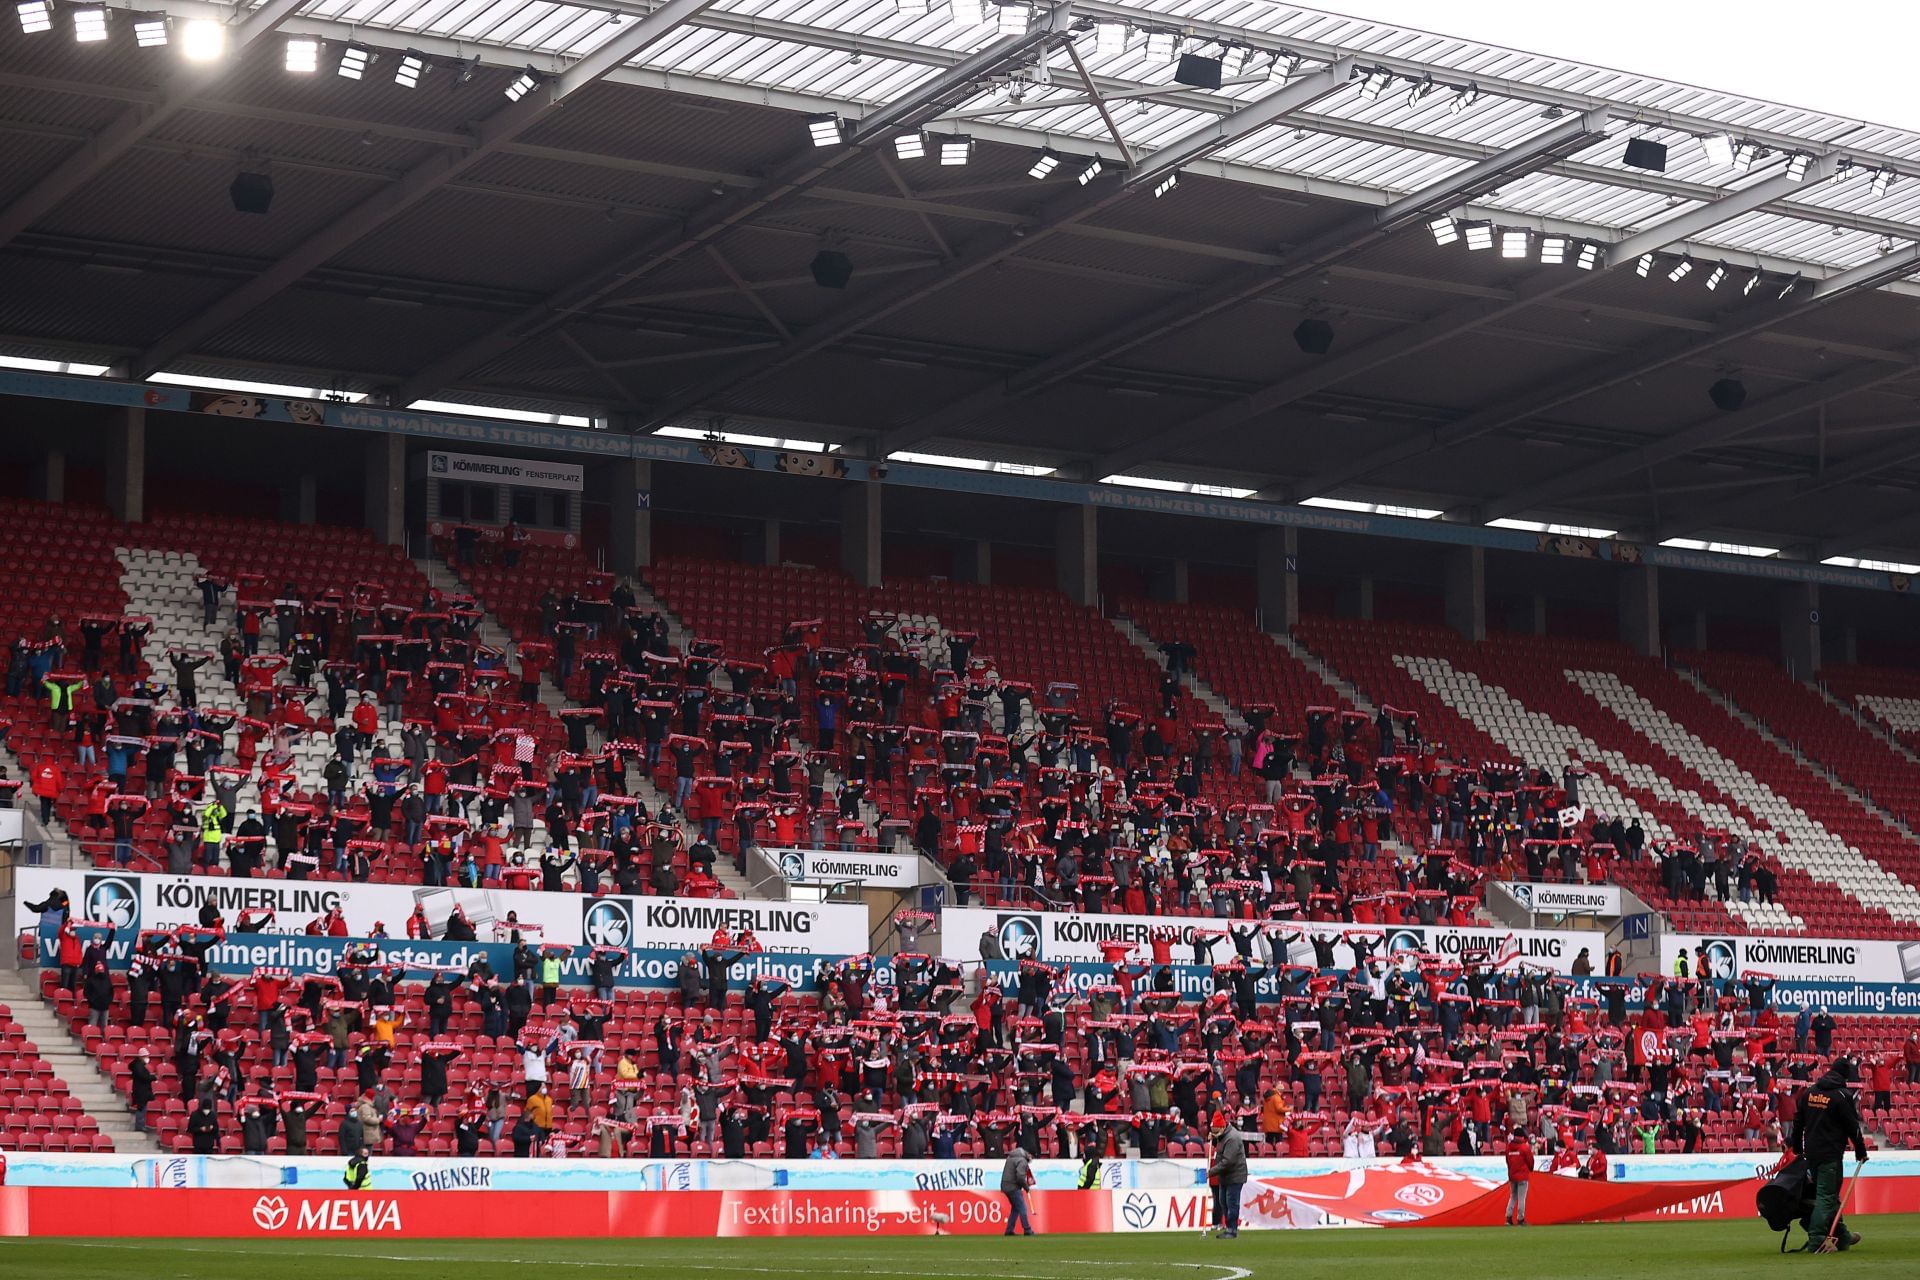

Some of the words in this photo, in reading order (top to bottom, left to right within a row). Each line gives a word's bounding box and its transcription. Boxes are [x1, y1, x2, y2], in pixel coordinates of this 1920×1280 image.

[489, 427, 566, 447] STEHEN
[453, 459, 521, 477] KÖMMERLING
[525, 470, 580, 483] FENSTERPLATZ
[637, 492, 650, 508] M
[1286, 558, 1296, 571] N
[812, 859, 897, 877] KÖMMERLING
[157, 878, 342, 914] KÖMMERLING
[935, 891, 943, 906] M
[1539, 890, 1605, 906] KÖMMERLING
[647, 899, 811, 933] KÖMMERLING
[1635, 918, 1647, 935] N
[1745, 939, 1855, 965] KÖMMERLING
[297, 1200, 402, 1231] MEWA
[728, 1200, 887, 1231] Textilsharing.
[946, 1201, 1010, 1225] 1908.
